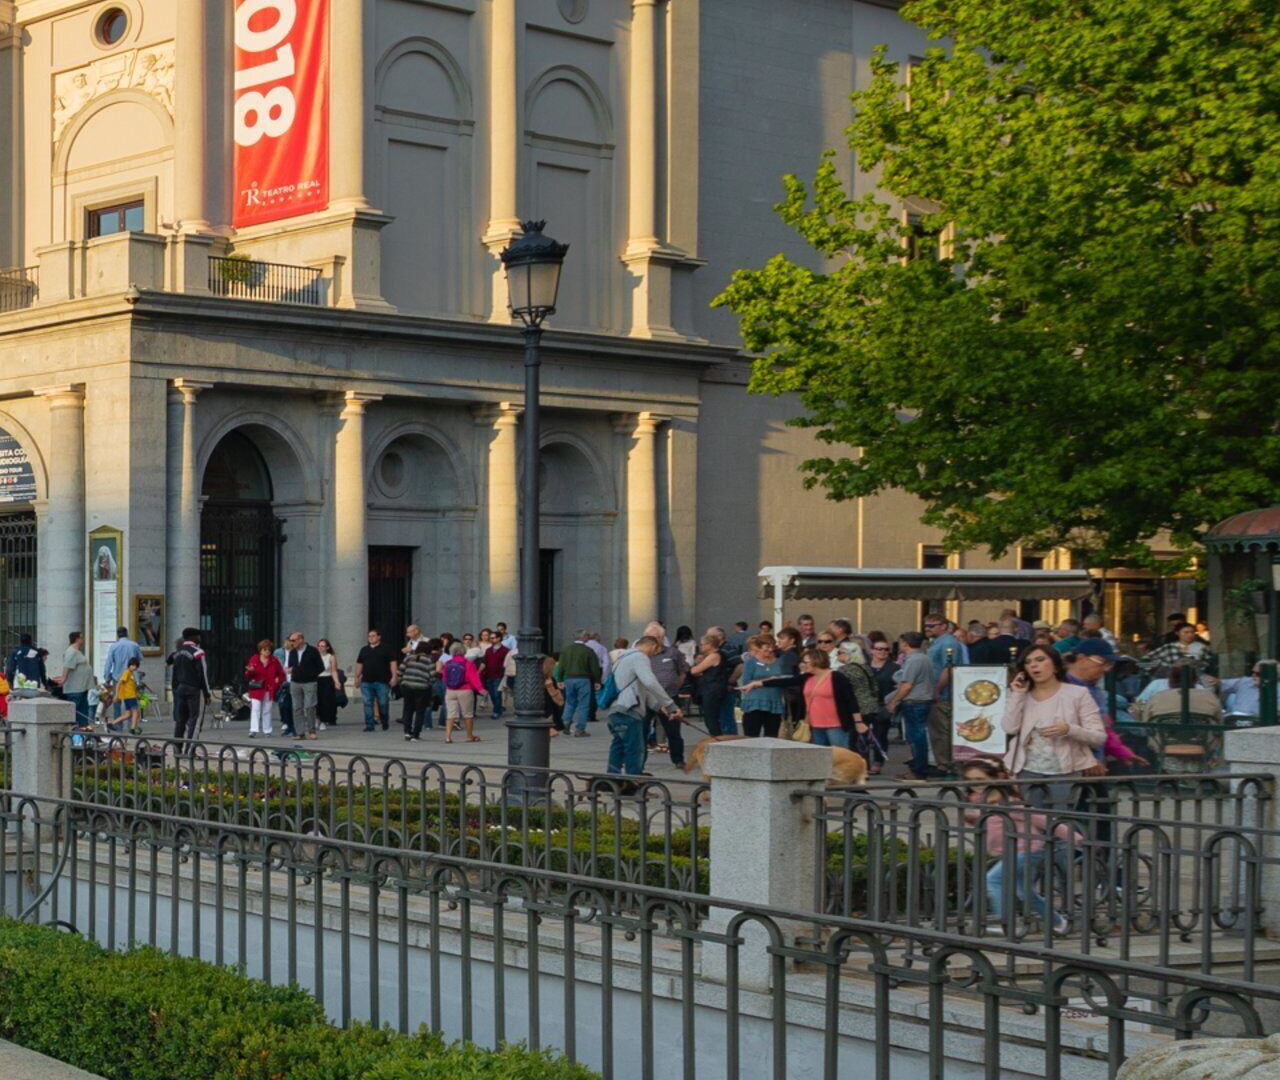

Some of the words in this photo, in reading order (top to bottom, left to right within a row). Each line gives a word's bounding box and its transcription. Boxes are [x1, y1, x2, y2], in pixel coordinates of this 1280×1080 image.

[263, 184, 296, 198] TEATRO
[297, 180, 321, 191] REAL
[14, 448, 26, 457] CO
